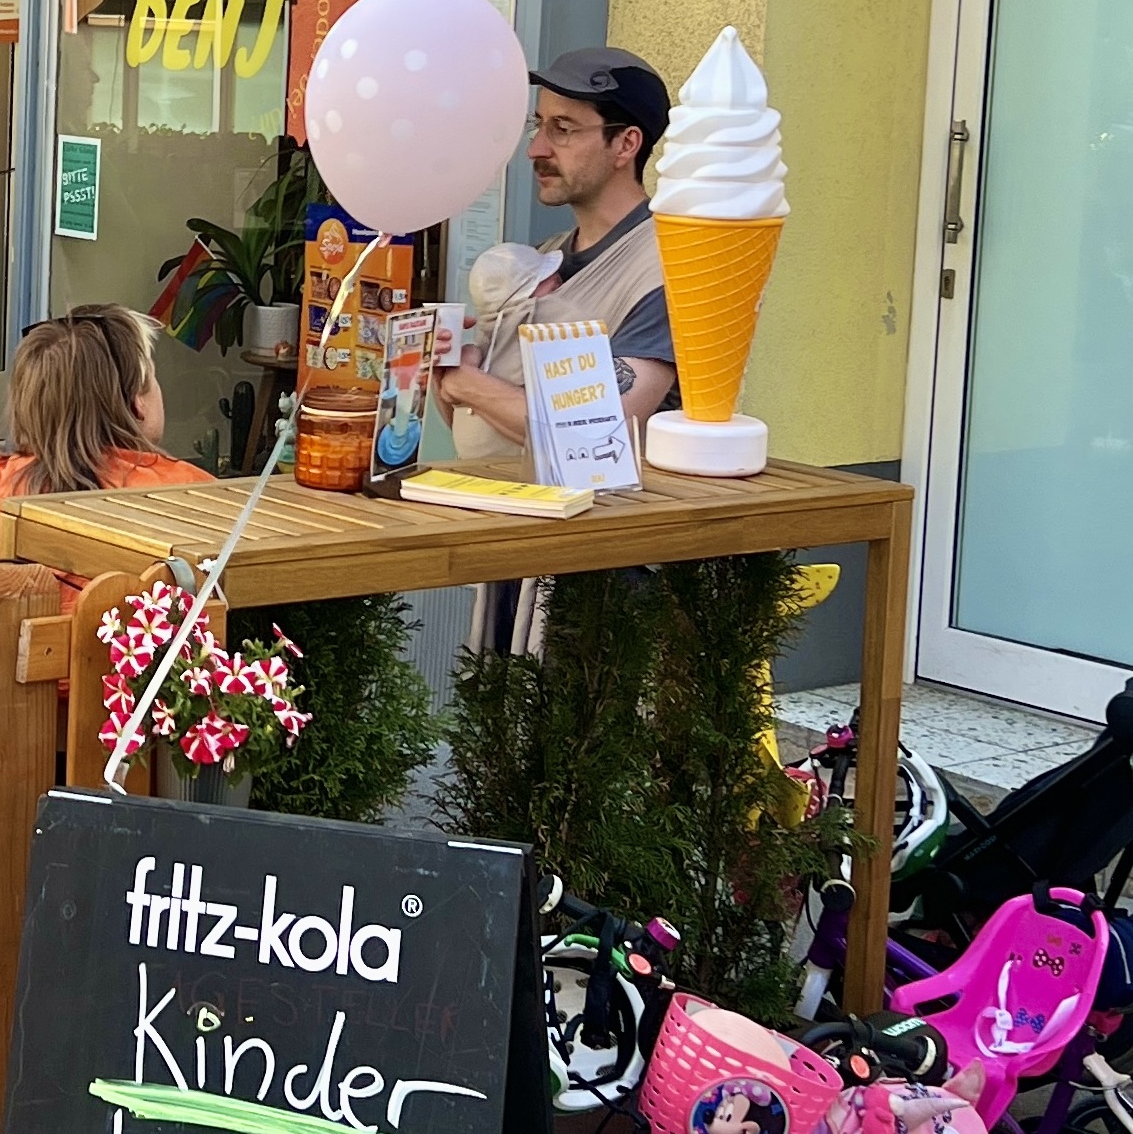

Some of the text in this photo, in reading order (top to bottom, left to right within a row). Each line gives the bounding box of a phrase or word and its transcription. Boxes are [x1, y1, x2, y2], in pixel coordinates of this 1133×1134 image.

[544, 352, 597, 379] HAST DU
[551, 382, 606, 411] HUNGER?
[133, 962, 488, 1134] Kinder
